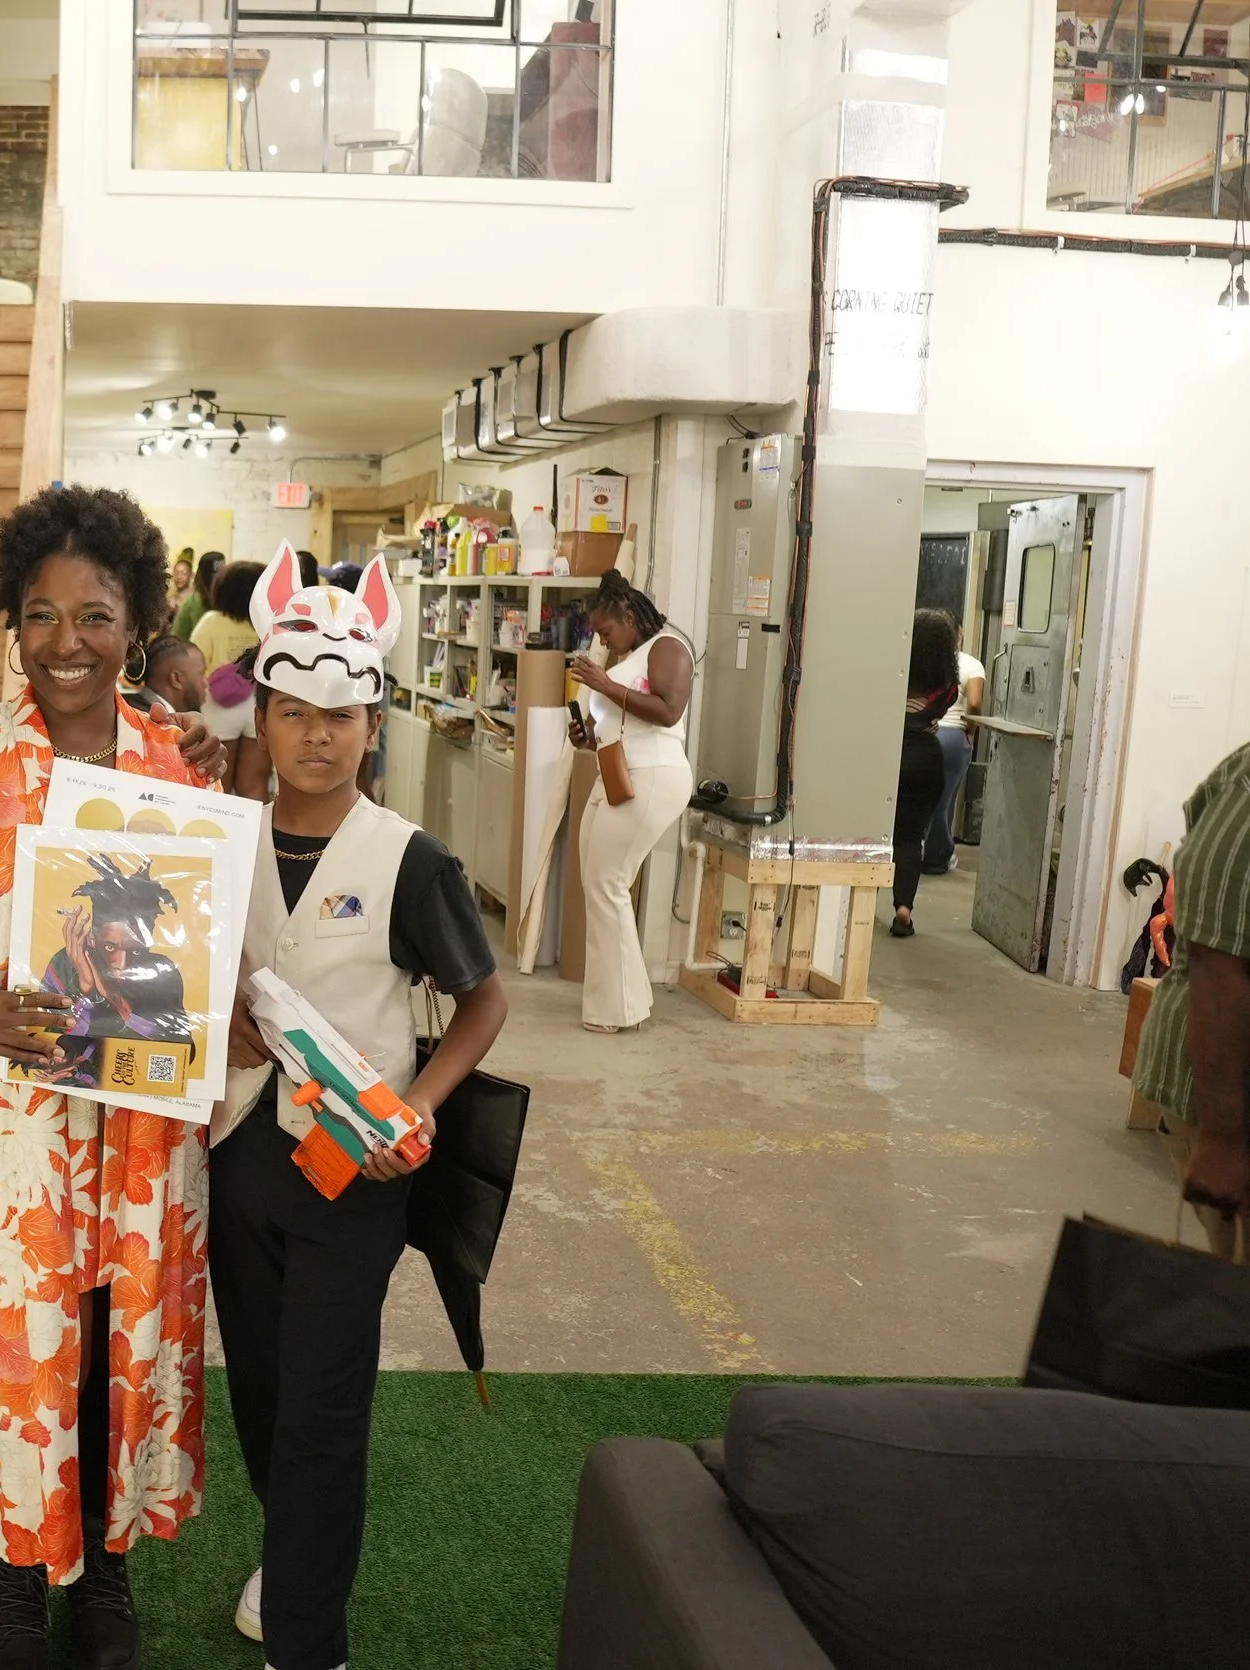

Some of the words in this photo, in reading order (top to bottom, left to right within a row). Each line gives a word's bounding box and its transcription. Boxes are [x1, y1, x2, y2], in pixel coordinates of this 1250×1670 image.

[893, 291, 934, 316] QUIET
[111, 1048, 129, 1083] CHEERS
[121, 1046, 136, 1086] CULTURE
